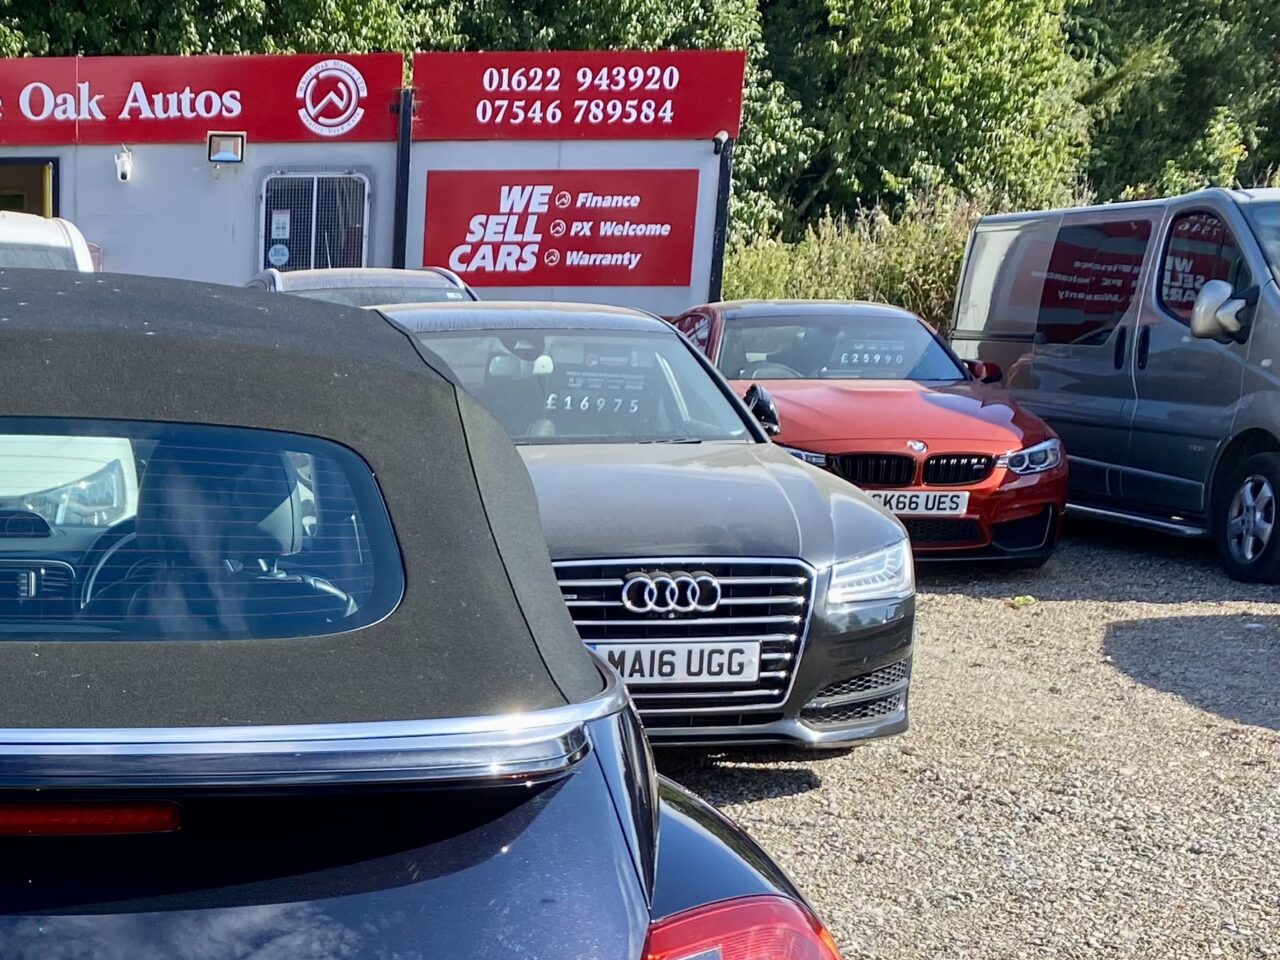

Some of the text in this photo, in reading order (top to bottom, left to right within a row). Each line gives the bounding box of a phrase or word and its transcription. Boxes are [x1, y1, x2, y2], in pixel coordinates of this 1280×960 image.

[482, 66, 680, 92] 01622 943920
[19, 81, 107, 121] Oak
[118, 81, 242, 120] Autos
[475, 99, 675, 124] 07546 789584
[499, 185, 554, 213] WE
[575, 192, 641, 208] Finance
[465, 214, 543, 242] SELL
[570, 221, 671, 236] PX Welcome
[448, 244, 539, 272] CARS
[565, 250, 642, 269] Warranty
[924, 494, 961, 511] UES
[607, 648, 745, 678] MA16 UGG
